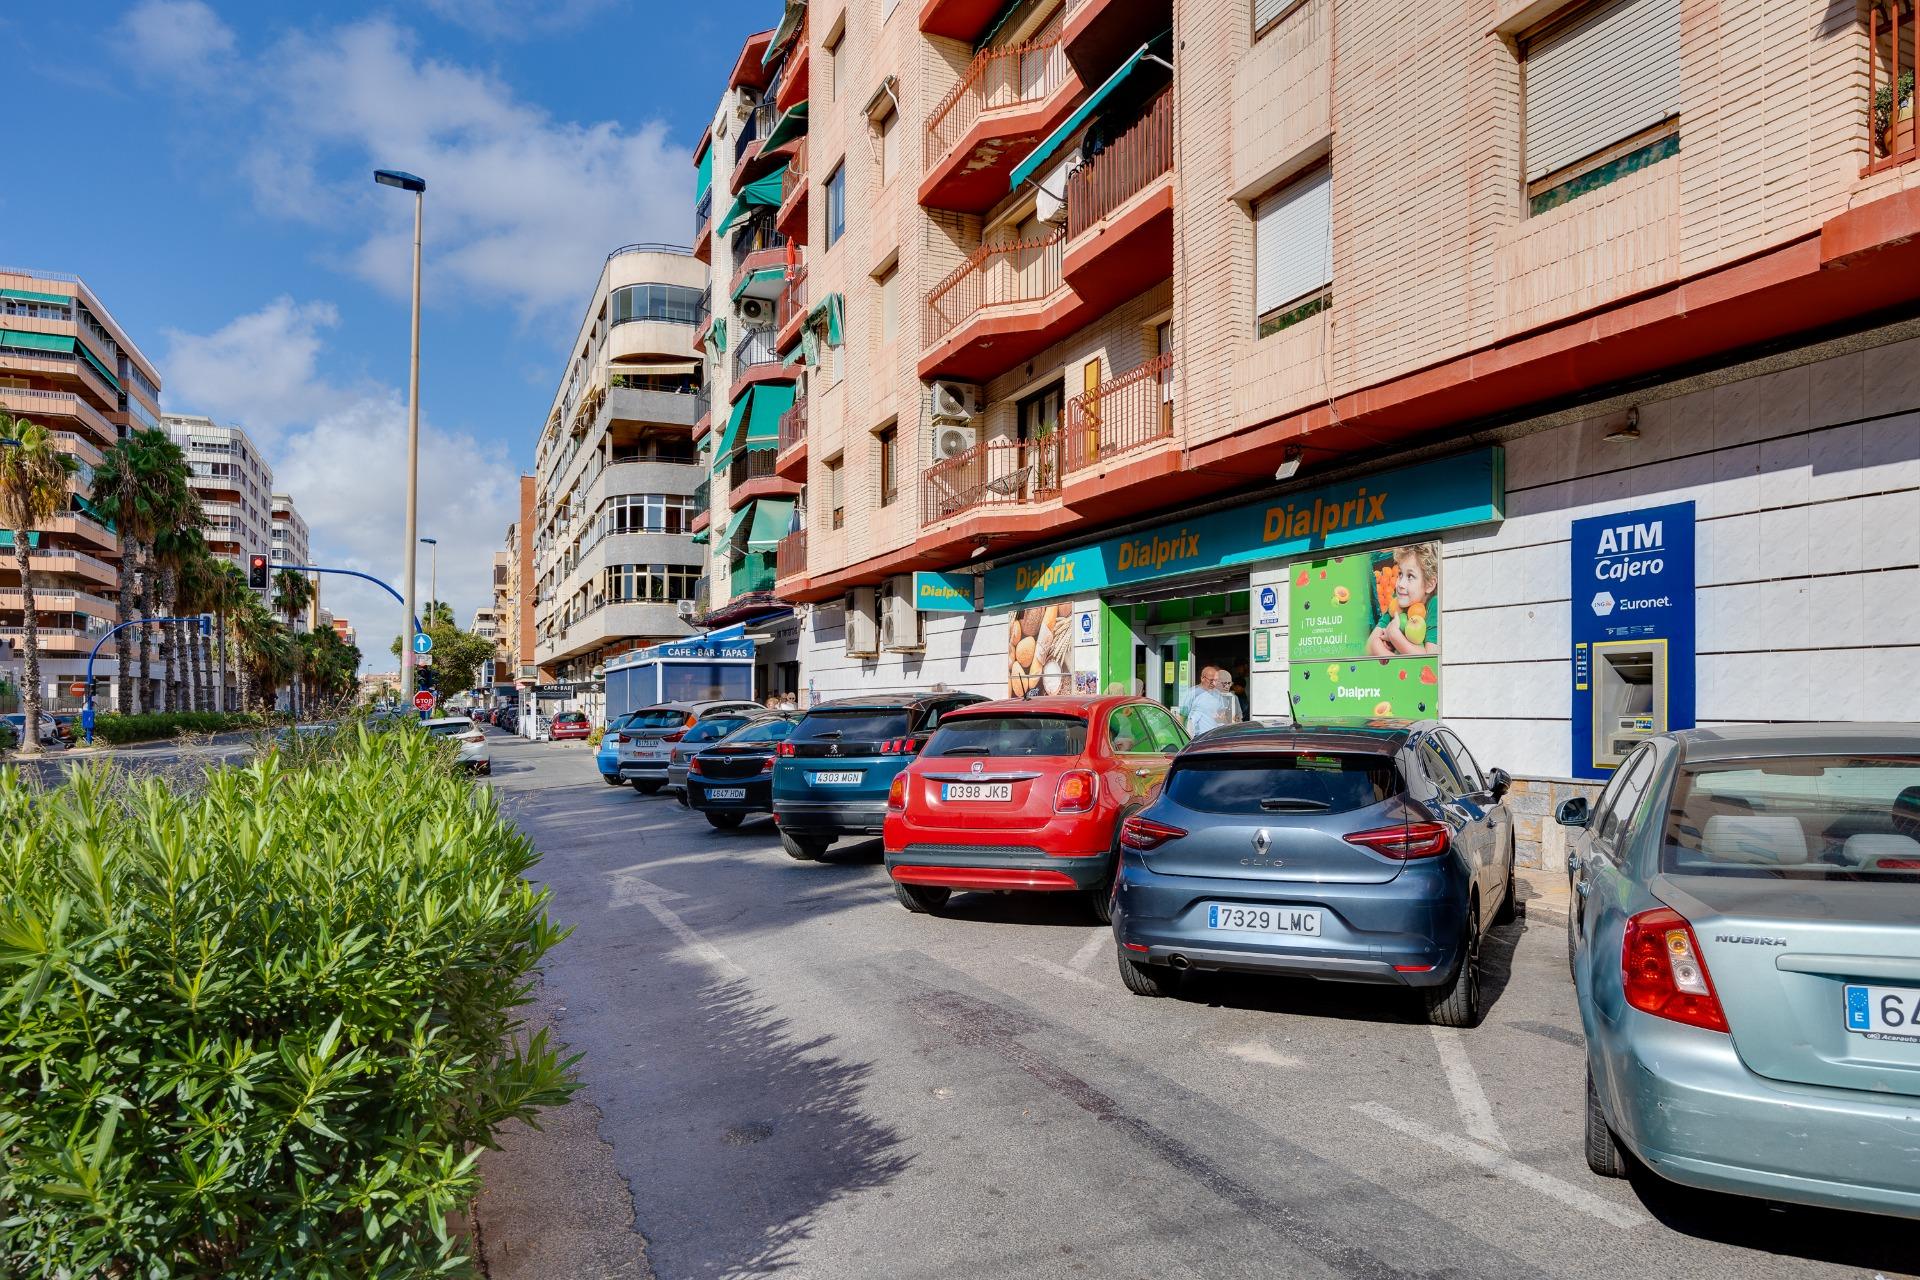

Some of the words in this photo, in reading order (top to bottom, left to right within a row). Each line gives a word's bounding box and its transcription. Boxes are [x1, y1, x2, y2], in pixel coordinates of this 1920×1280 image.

[1263, 487, 1388, 543] Dialprix
[1597, 520, 1663, 555] ATM
[1117, 528, 1200, 571] Dialprix
[1016, 556, 1076, 592] Dialprix
[1595, 556, 1664, 583] Cajero
[921, 584, 971, 600] Dialprix
[1305, 617, 1315, 627] TU
[1316, 615, 1343, 626] SALUD
[1298, 636, 1323, 647] JUSTO
[667, 648, 691, 656] CAFE
[697, 648, 715, 657] BAR
[721, 649, 748, 657] TAPAS
[1337, 686, 1381, 700] Dialprix
[817, 773, 840, 783] 4303
[841, 773, 859, 782] MGN
[950, 786, 981, 799] 0398
[985, 787, 1009, 799] JKB
[1240, 858, 1284, 867] CLIO
[1221, 908, 1270, 929] 7329
[1277, 912, 1315, 932] LMC
[1715, 935, 1788, 947] NUBIRA
[1854, 1012, 1865, 1022] E
